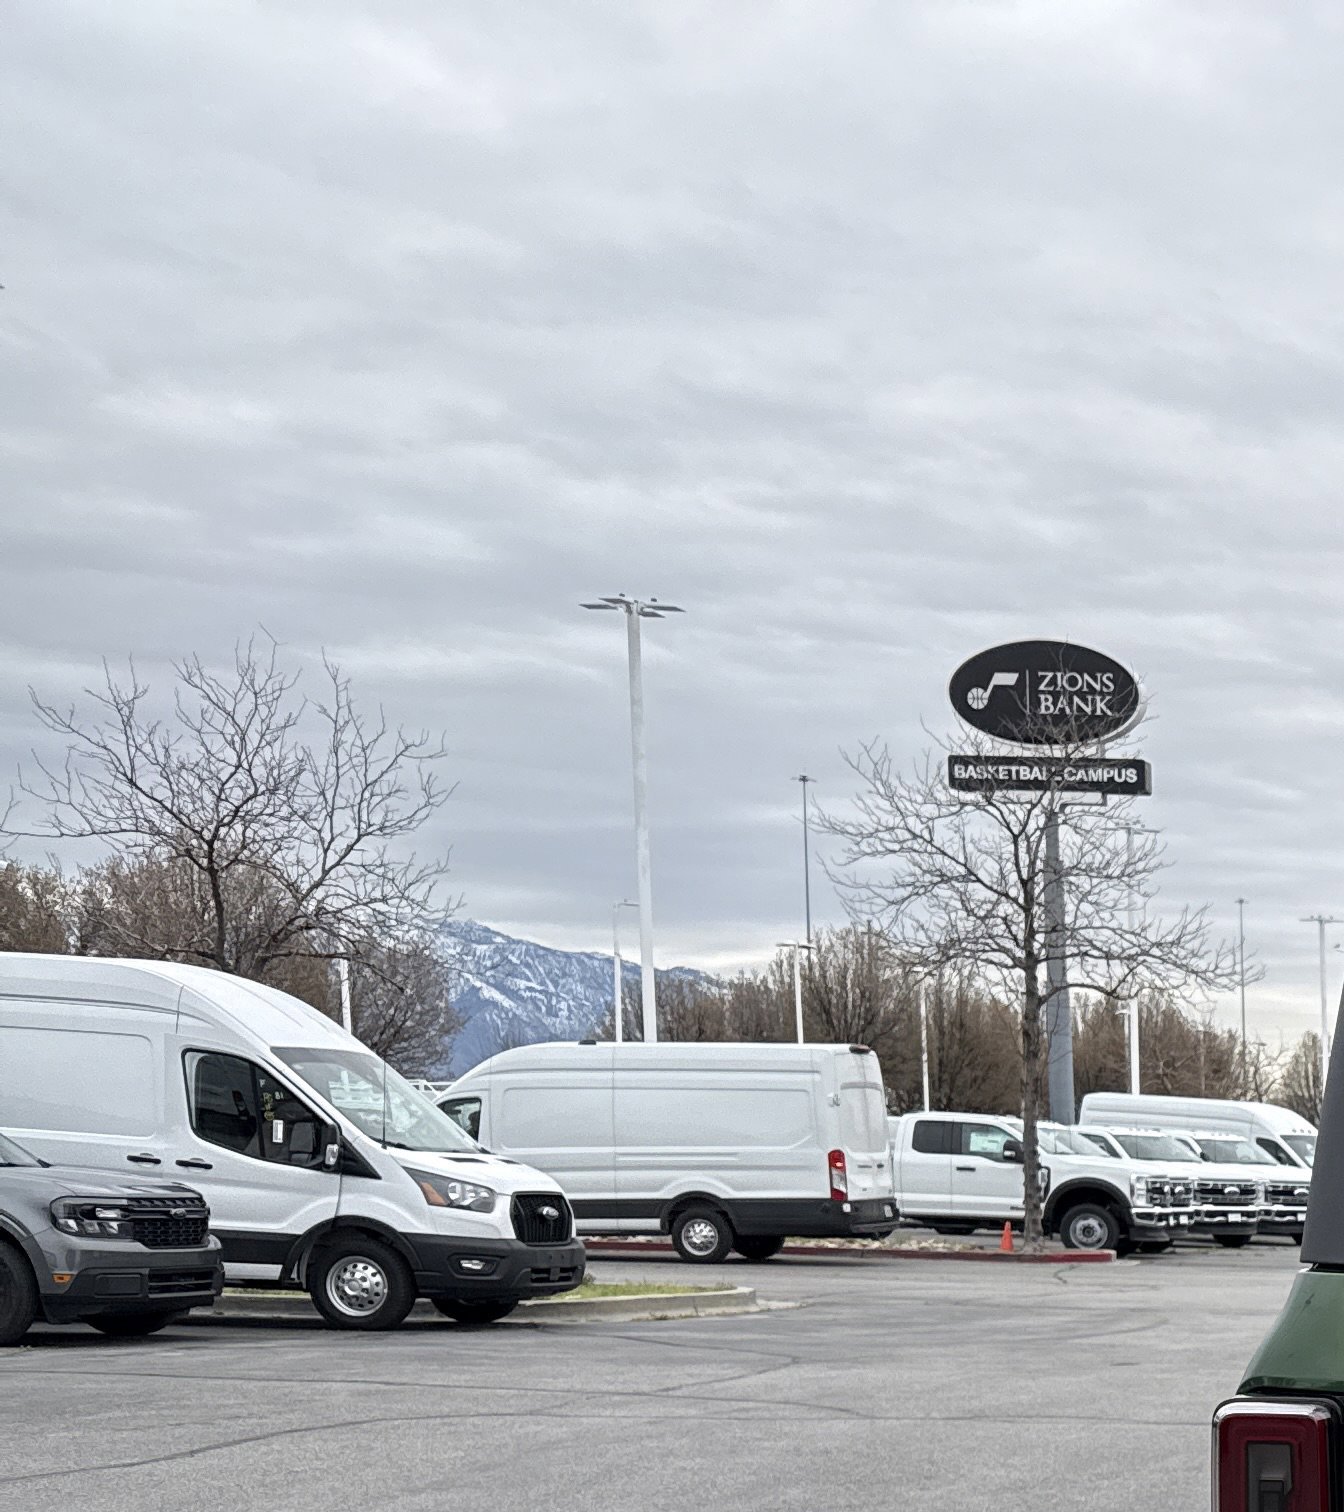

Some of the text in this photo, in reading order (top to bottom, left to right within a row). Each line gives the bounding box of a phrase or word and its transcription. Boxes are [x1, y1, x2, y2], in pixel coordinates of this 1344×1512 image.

[1037, 671, 1114, 693] ZIONS
[1038, 693, 1113, 716] BANK
[954, 763, 1138, 784] BASKETBALL CAMPUS
